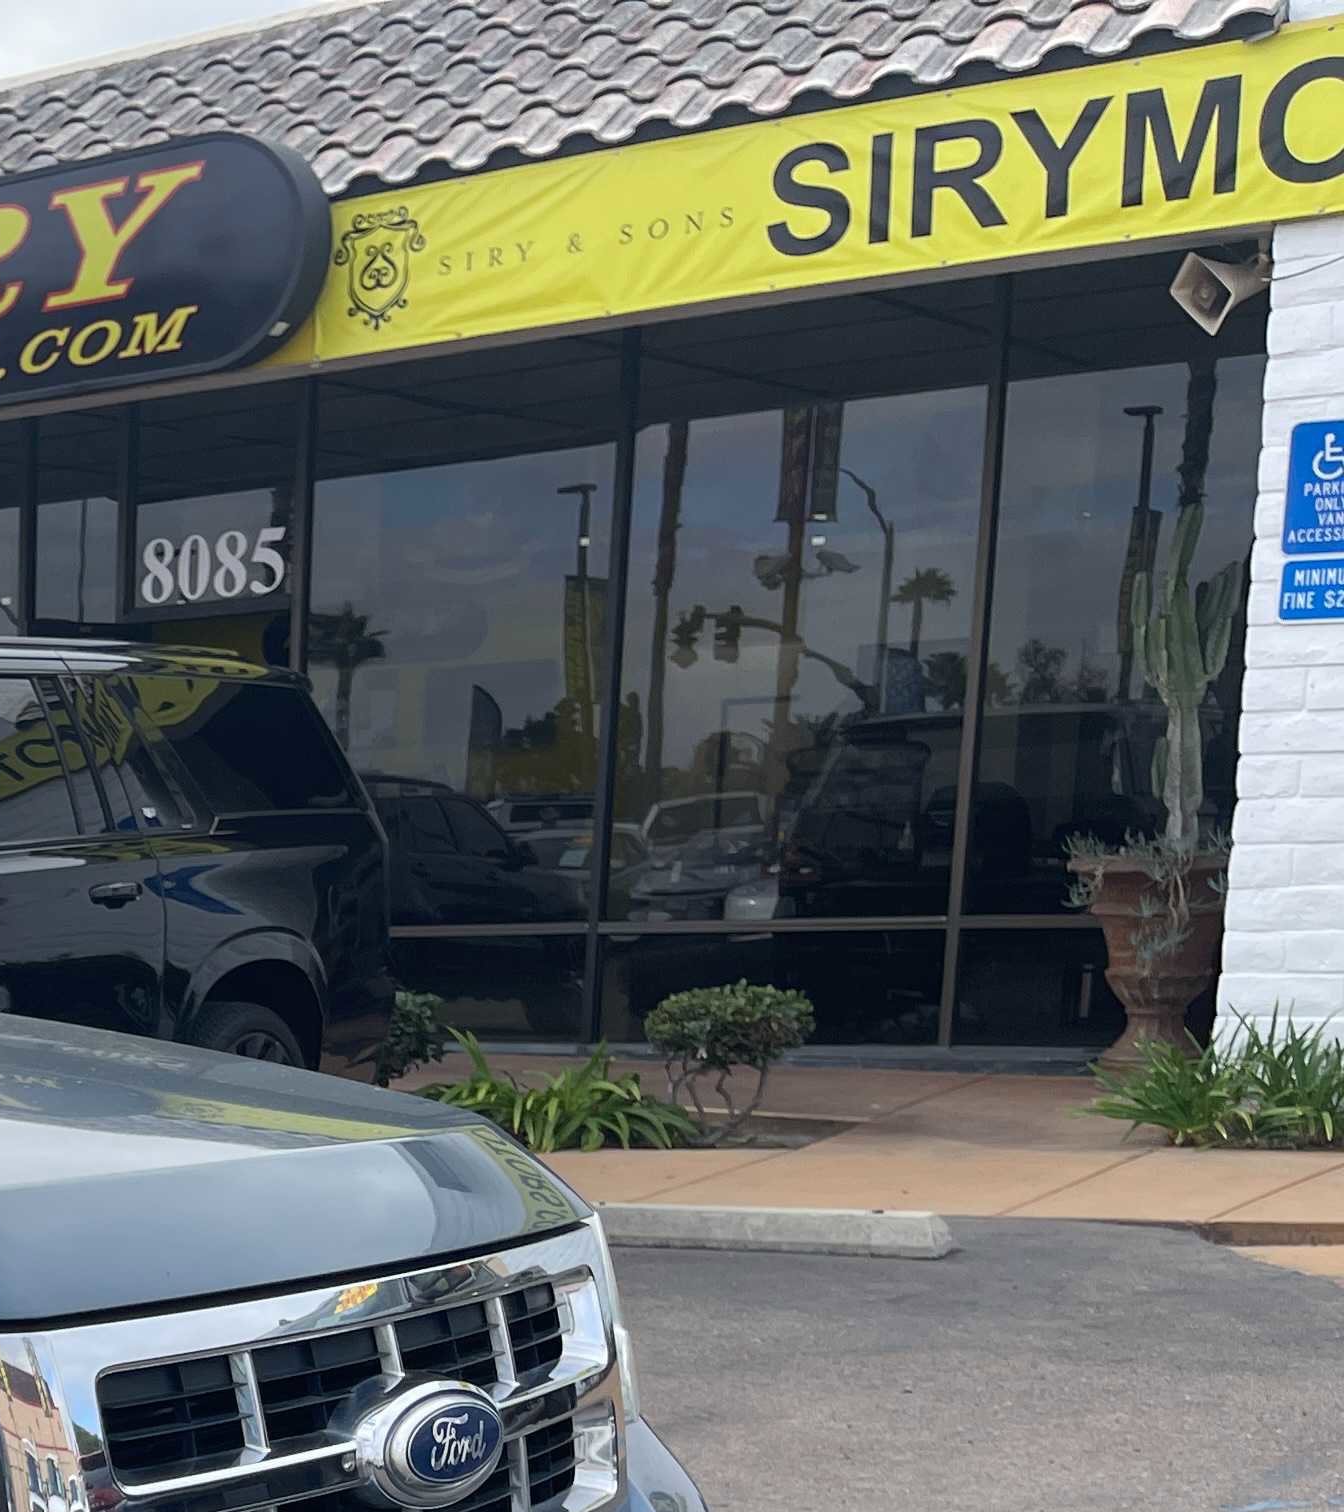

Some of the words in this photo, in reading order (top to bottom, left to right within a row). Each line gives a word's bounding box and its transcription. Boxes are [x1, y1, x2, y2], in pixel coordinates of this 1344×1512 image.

[437, 241, 537, 278] SIRY
[565, 233, 586, 254] &
[619, 207, 738, 247] SONS
[141, 526, 286, 604] 8085
[1282, 592, 1315, 610] FINE
[430, 1412, 488, 1472] Ford
